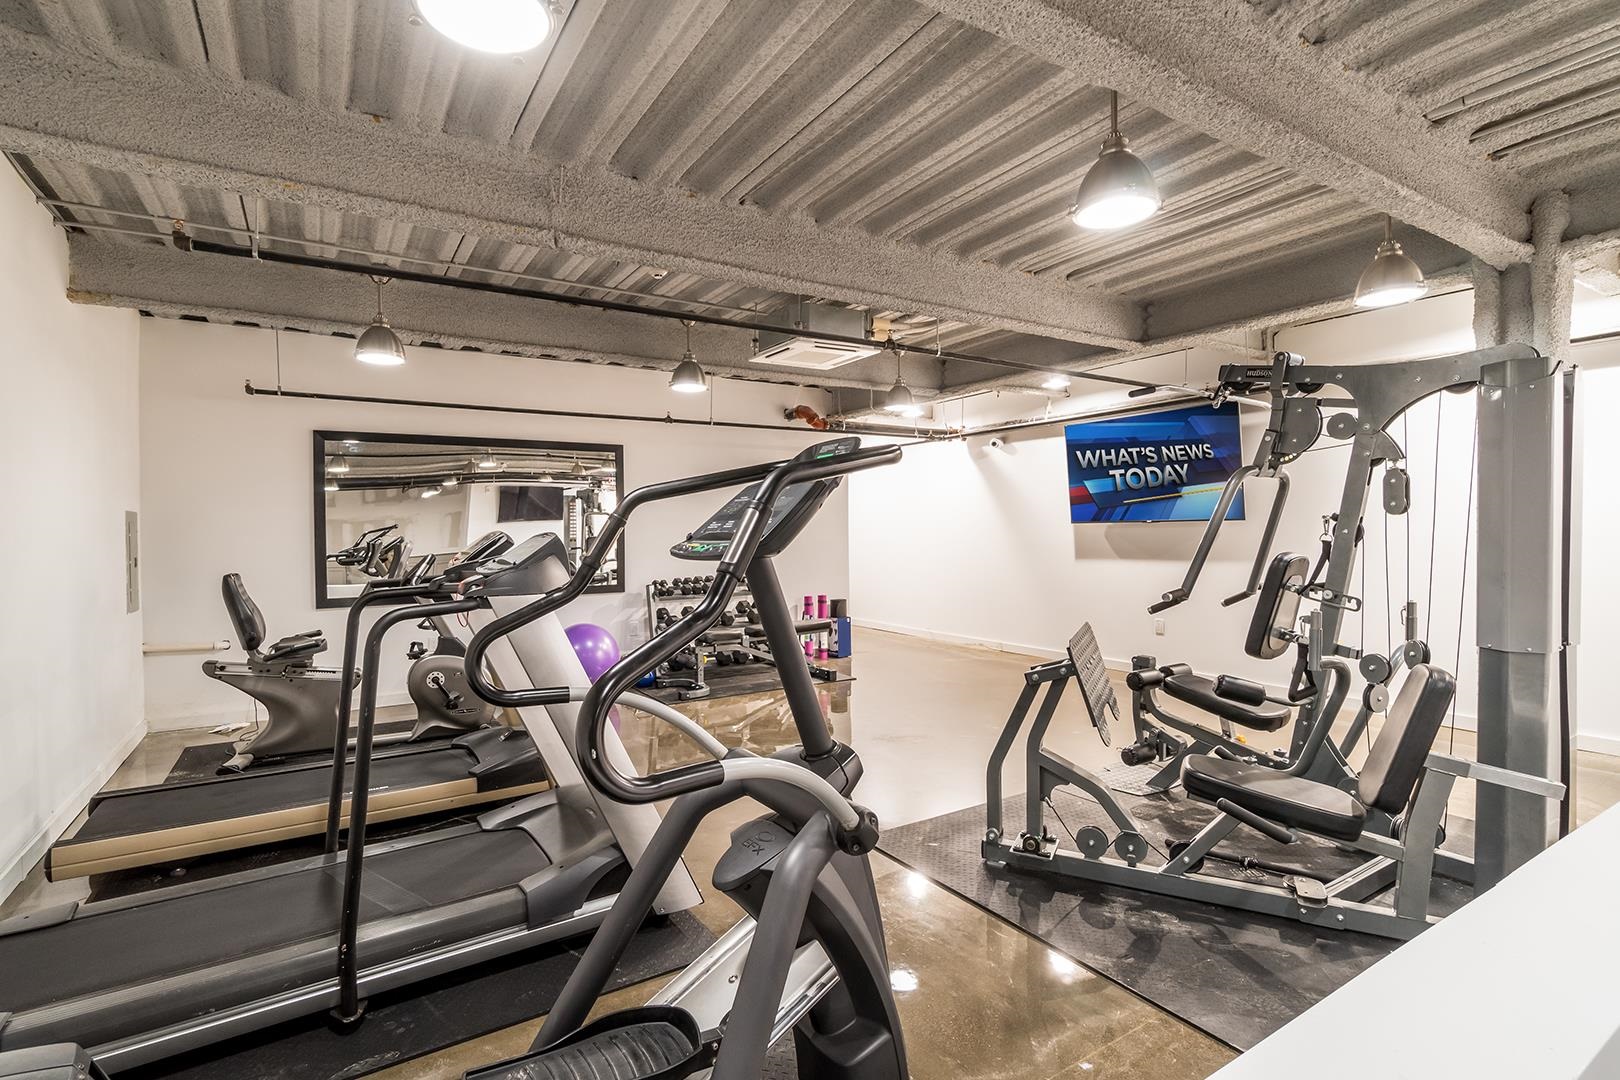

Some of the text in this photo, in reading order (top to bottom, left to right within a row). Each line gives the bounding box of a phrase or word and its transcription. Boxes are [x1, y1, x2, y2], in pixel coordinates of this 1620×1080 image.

[1246, 369, 1272, 377] HUDSON
[1075, 443, 1215, 469] WHAT'S NEWS
[1108, 463, 1190, 492] TODAY
[742, 838, 765, 856] EFX
